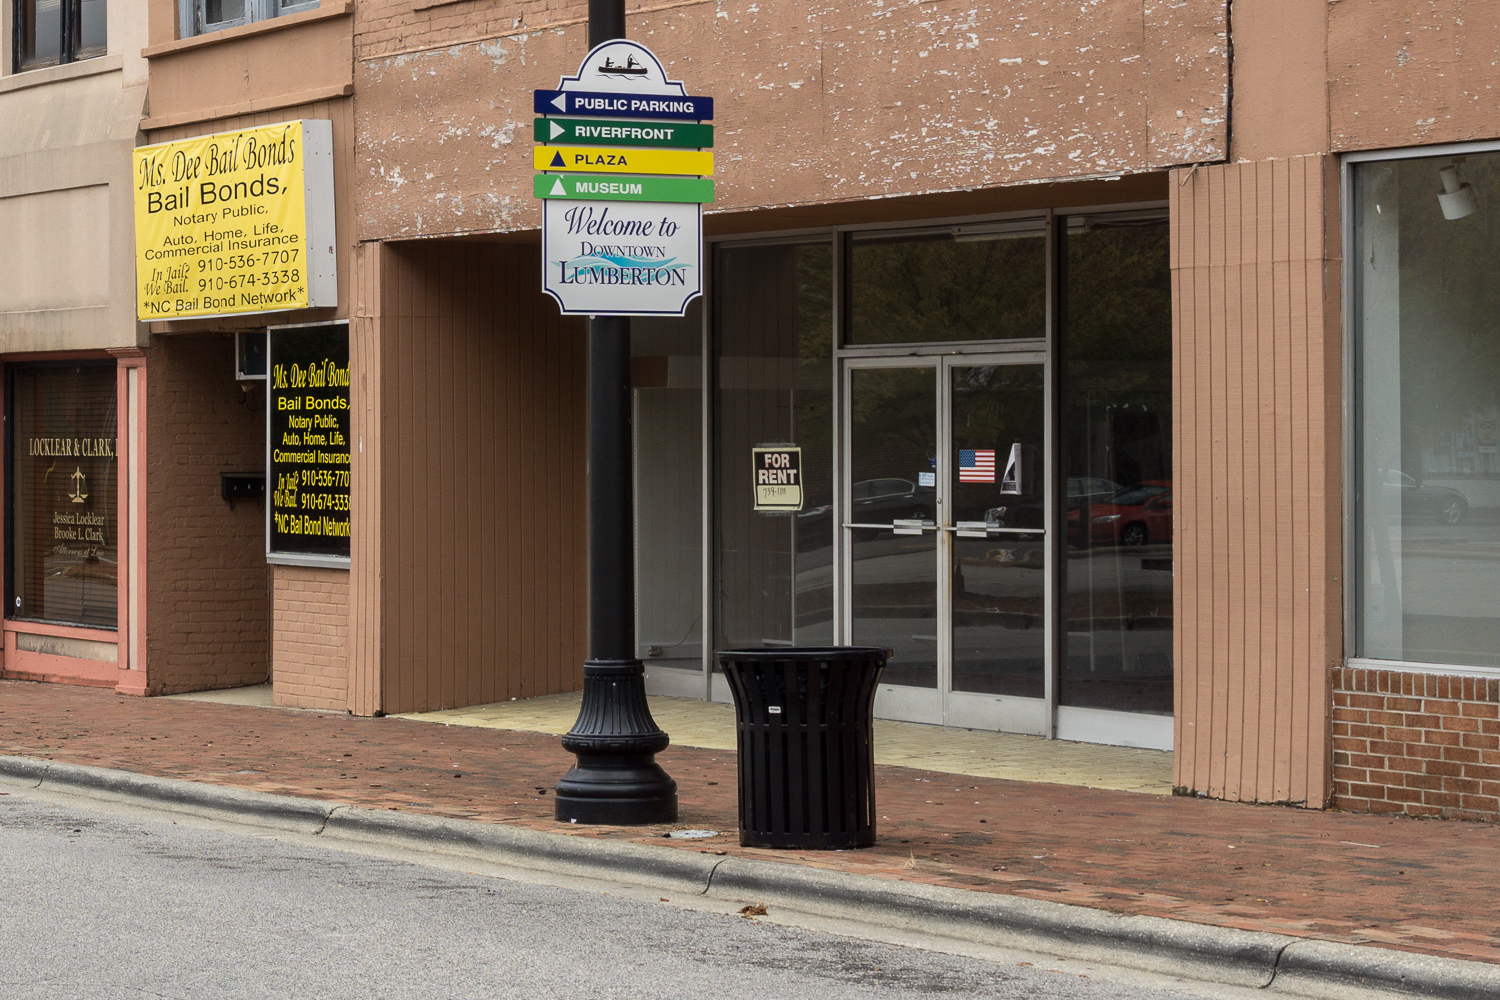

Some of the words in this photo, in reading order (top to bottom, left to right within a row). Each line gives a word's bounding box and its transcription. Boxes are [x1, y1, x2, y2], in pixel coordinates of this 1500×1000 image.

[575, 98, 627, 111] PUBLIC
[631, 100, 694, 113] PARKING
[575, 126, 674, 140] RIVERFRONT
[139, 157, 166, 190] Ms.
[171, 150, 201, 183] Dee
[205, 134, 242, 176] Bail
[243, 125, 296, 170] Bonds
[575, 154, 627, 166] PLAZA
[148, 186, 190, 214] Bail
[200, 173, 288, 205] Bonds,
[575, 182, 642, 194] MUSEUM
[173, 211, 218, 227] Notary
[222, 204, 269, 219] Public,
[564, 206, 656, 238] Welcome
[659, 216, 680, 238] to
[163, 234, 197, 247] Auto,
[204, 228, 247, 242] Home,
[253, 223, 284, 235] Life,
[145, 241, 224, 260] Commercial
[228, 233, 299, 251] Insurance
[581, 241, 666, 258] DOWNTOWN
[151, 267, 163, 282] In
[164, 262, 190, 281] Jail?
[198, 249, 299, 273] 910-536-7707
[559, 260, 686, 286] LUMBERTON
[144, 282, 161, 297] We
[163, 279, 189, 296] Bail.
[198, 269, 300, 292] 910-674-3338
[175, 297, 199, 312] Bail
[203, 294, 236, 309] Bond
[273, 364, 288, 389] Ms.
[290, 363, 306, 389] Dee
[308, 358, 328, 389] Bail
[328, 362, 350, 388] Bond
[278, 396, 301, 410] Bail
[288, 415, 312, 431] Notary
[314, 415, 339, 430] Public,
[282, 432, 301, 447] Auto,
[303, 432, 328, 447] Home,
[329, 431, 345, 447] Life,
[29, 438, 72, 456] LOCKLEAR
[74, 438, 80, 456] &
[82, 438, 113, 460] CLARK,
[274, 449, 316, 463] Commercial
[764, 453, 790, 468] FOR
[277, 473, 285, 490] In
[285, 471, 299, 491] Jail?
[758, 469, 797, 484] RENT
[274, 490, 284, 507] We
[53, 512, 75, 524] Jessica
[76, 512, 104, 525] Locklear
[290, 514, 303, 535] Bail
[304, 515, 322, 536] Bond
[54, 526, 76, 539] Brooke
[78, 527, 84, 540] L.
[85, 527, 103, 541] Clark
